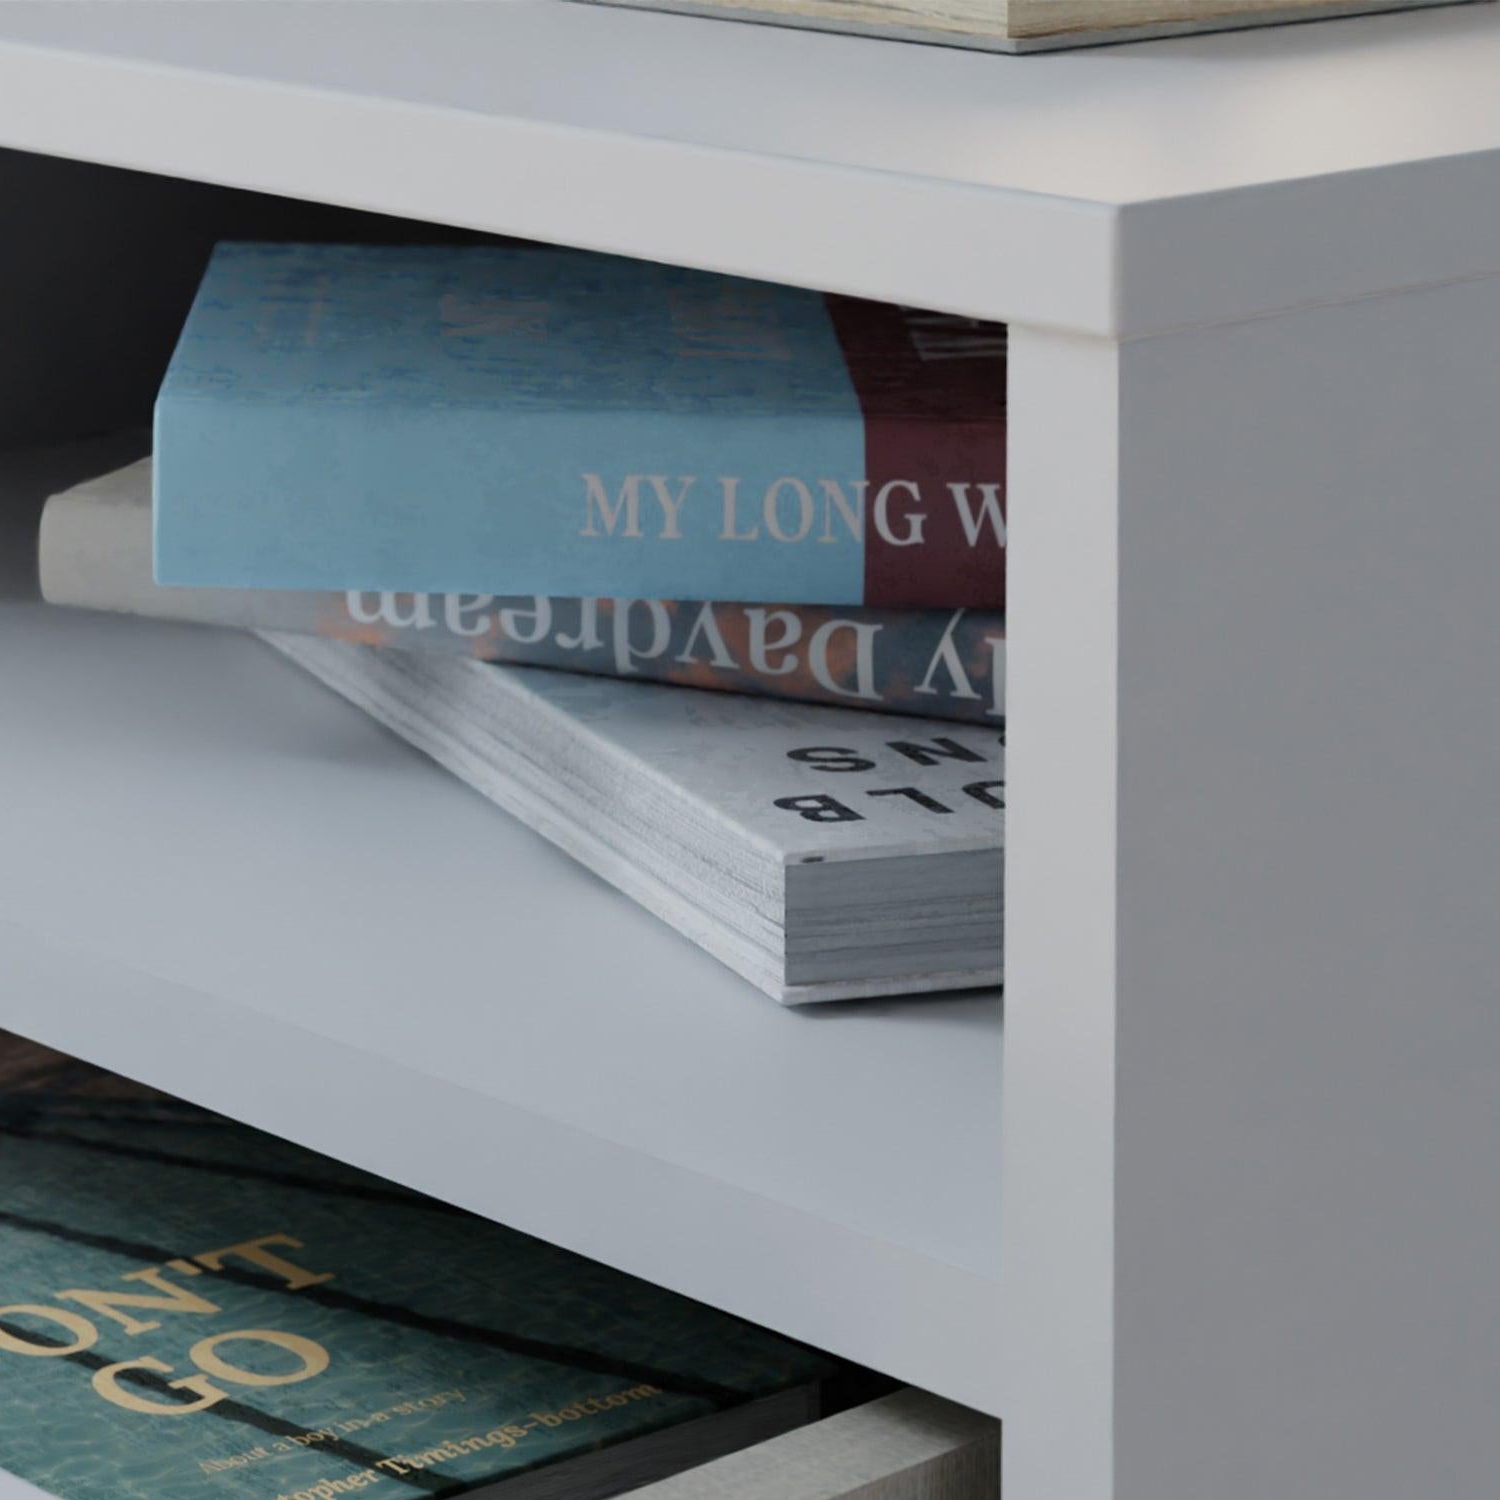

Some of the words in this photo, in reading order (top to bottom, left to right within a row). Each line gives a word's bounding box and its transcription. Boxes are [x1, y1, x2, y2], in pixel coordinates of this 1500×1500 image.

[579, 473, 698, 539] MY
[717, 477, 928, 546] LONG
[346, 590, 884, 701] Daydream
[786, 737, 1006, 772] NS
[92, 1329, 330, 1415] GO
[198, 1445, 275, 1476] About
[274, 1440, 291, 1452] a
[287, 1427, 340, 1446] boy
[392, 1389, 467, 1415] story
[376, 1382, 663, 1475] Timings-bottom
